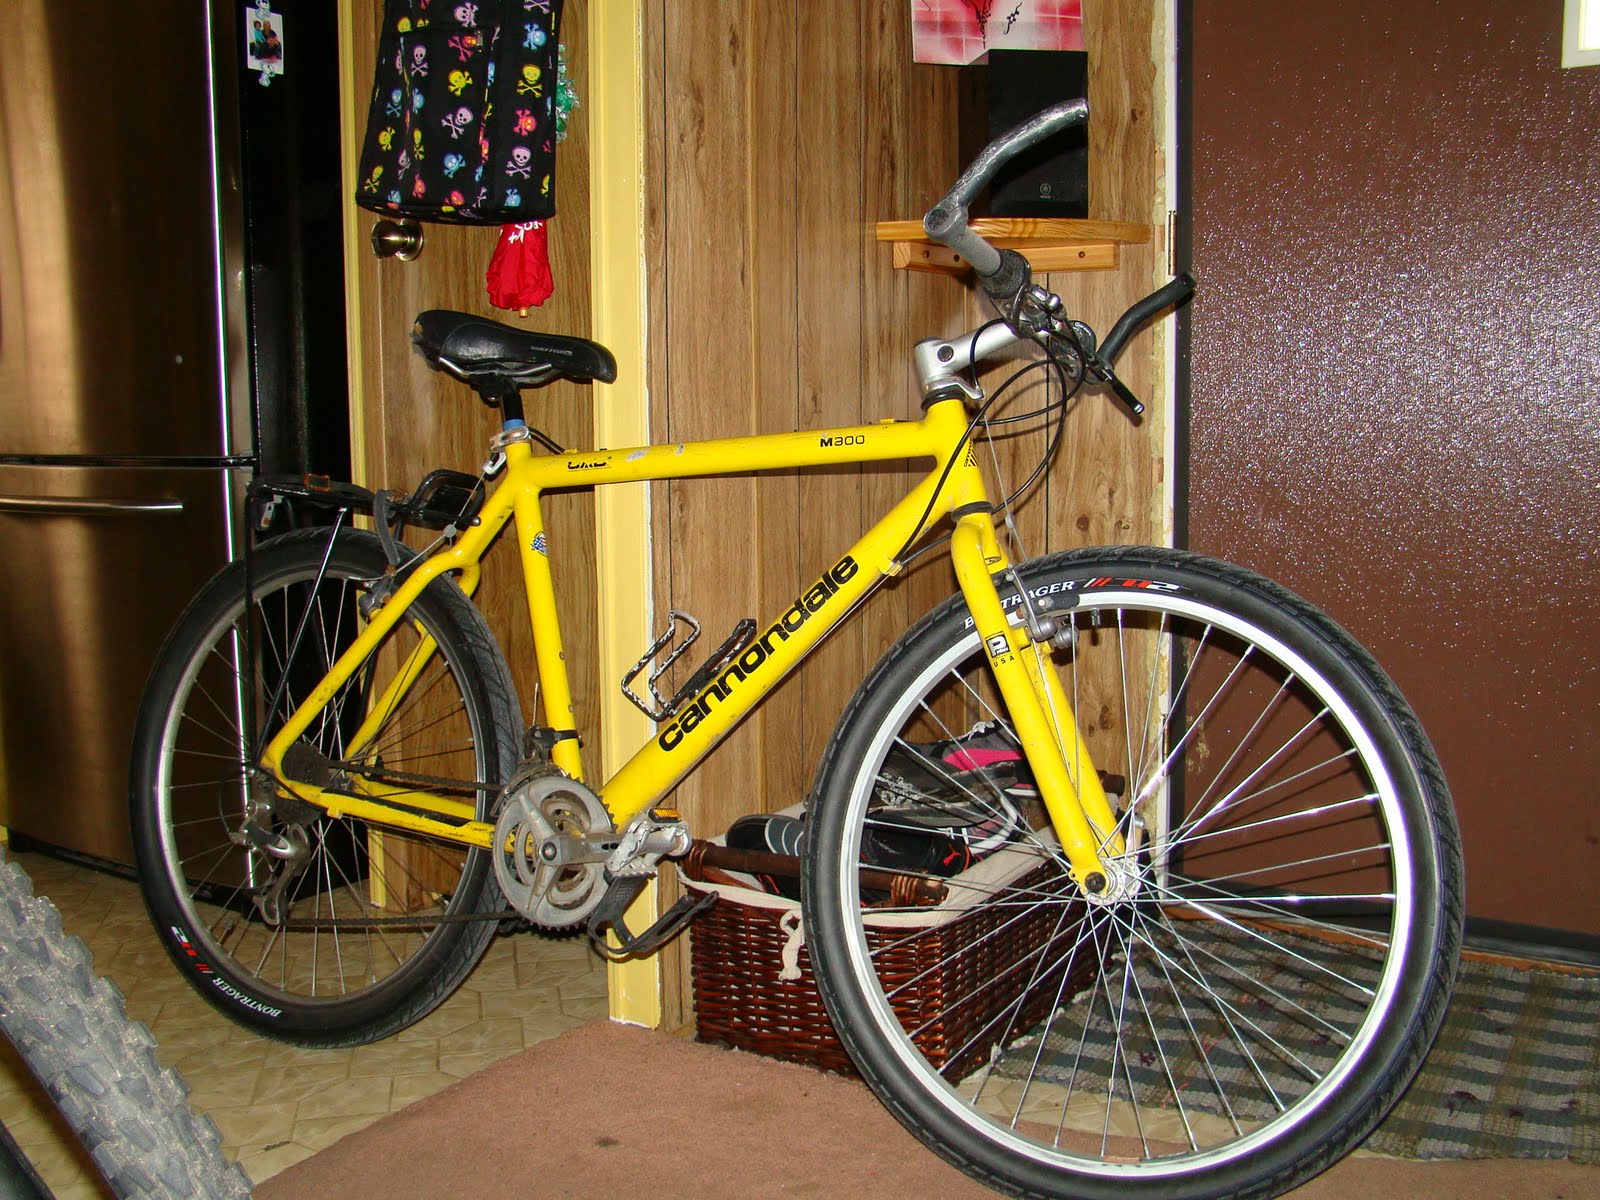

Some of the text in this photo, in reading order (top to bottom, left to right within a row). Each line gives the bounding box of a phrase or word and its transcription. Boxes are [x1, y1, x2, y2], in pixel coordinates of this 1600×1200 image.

[820, 435, 865, 447] M300
[964, 580, 1075, 630] BTRAGER
[659, 555, 859, 752] cannondale
[212, 977, 282, 1018] BONTRAGER
